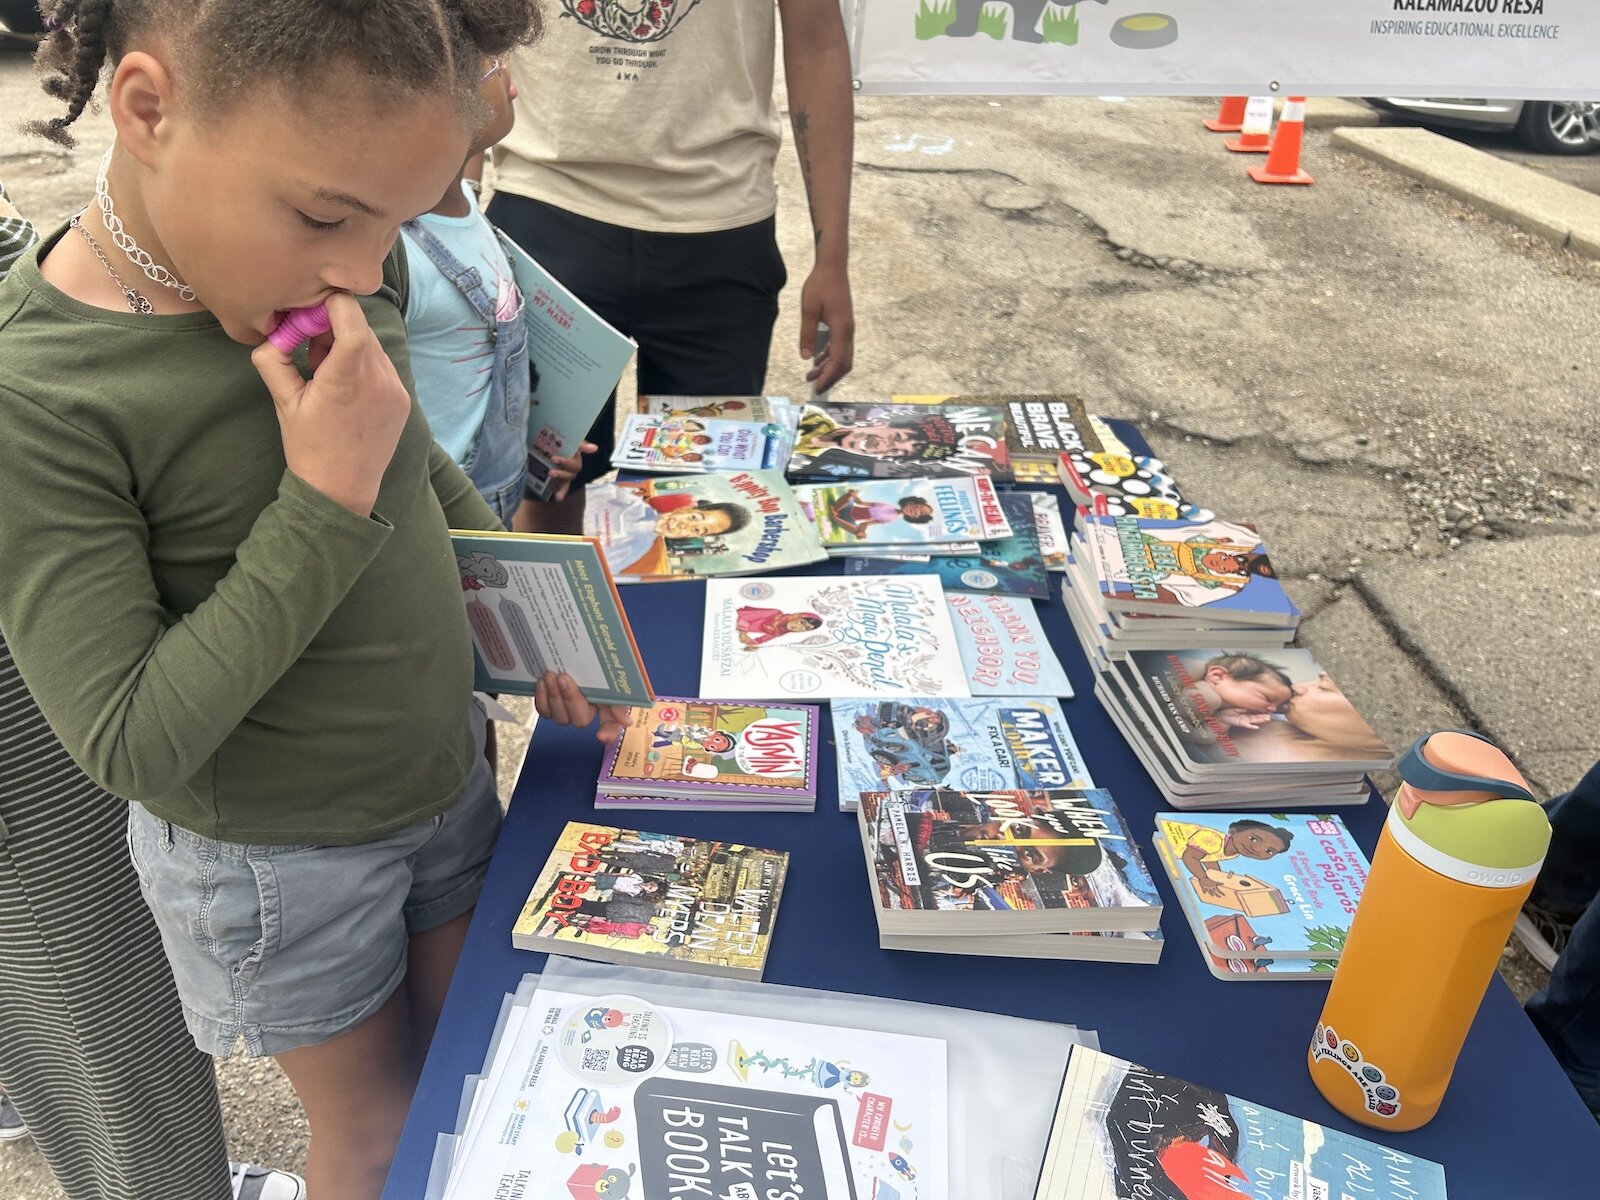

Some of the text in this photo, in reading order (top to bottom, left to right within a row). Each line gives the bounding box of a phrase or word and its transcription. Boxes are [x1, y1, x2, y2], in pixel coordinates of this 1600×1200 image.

[1393, 0, 1544, 15] KALAMAZOO RESA
[1370, 20, 1560, 39] INSPIRING EDUCATIONAL EXCELLENCE
[589, 46, 612, 54] GROW
[613, 46, 647, 57] THROUGH
[596, 56, 611, 65] YOU
[612, 57, 624, 66] GO
[717, 431, 732, 456] You Can
[1009, 402, 1036, 448] BEAUTIFUL
[1026, 402, 1059, 450] BRAVE
[1047, 402, 1086, 450] BLACK
[758, 496, 782, 514] Bop
[933, 485, 969, 535] FEELINGS
[742, 514, 791, 564] Barbershop
[574, 559, 632, 696] Meet Elephant Gerald and Piggie
[720, 598, 733, 677] MALALA YOUSAFZAI
[846, 596, 887, 639] Magic
[876, 583, 931, 657] Malala's
[949, 594, 1003, 689] NEIGHBOR!
[981, 594, 1041, 686] THANK YOU,
[860, 637, 904, 689] Pencil
[744, 722, 806, 775] YASMIN
[987, 725, 1011, 768] FIX A CAR!
[1011, 711, 1066, 786] MAKER
[965, 793, 1040, 833] LOOK
[1037, 813, 1070, 835] you
[1053, 796, 1127, 841] WHEN
[570, 831, 612, 873] BAD
[893, 806, 918, 883] PAMELA N. HARRIS
[923, 852, 995, 890] US
[1288, 854, 1323, 910] House for Birds
[1298, 855, 1326, 890] Beautiful
[1316, 863, 1357, 915] pájaros
[1319, 839, 1348, 871] casa
[1344, 874, 1364, 897] para
[1466, 869, 1522, 886] owala
[546, 878, 592, 928] BOY
[653, 883, 701, 947] MYERS
[1283, 873, 1316, 921] Grace Lin
[687, 900, 732, 951] DEAN
[723, 888, 769, 956] WALTER
[639, 1011, 653, 1032] TALKING
[534, 1045, 549, 1075] KALAMAZOO
[623, 1048, 633, 1069] SING
[630, 1048, 640, 1070] READ
[637, 1050, 648, 1069] TALK
[678, 1053, 689, 1069] NEW
[690, 1049, 701, 1067] READ
[528, 1074, 538, 1088] RESA
[1352, 1071, 1369, 1088] ARE
[1366, 1088, 1376, 1110] VALID
[511, 1114, 526, 1146] GREAT START
[863, 1096, 876, 1131] CHARACTER
[717, 1116, 754, 1179] TALK
[1342, 1153, 1375, 1192] ALL
